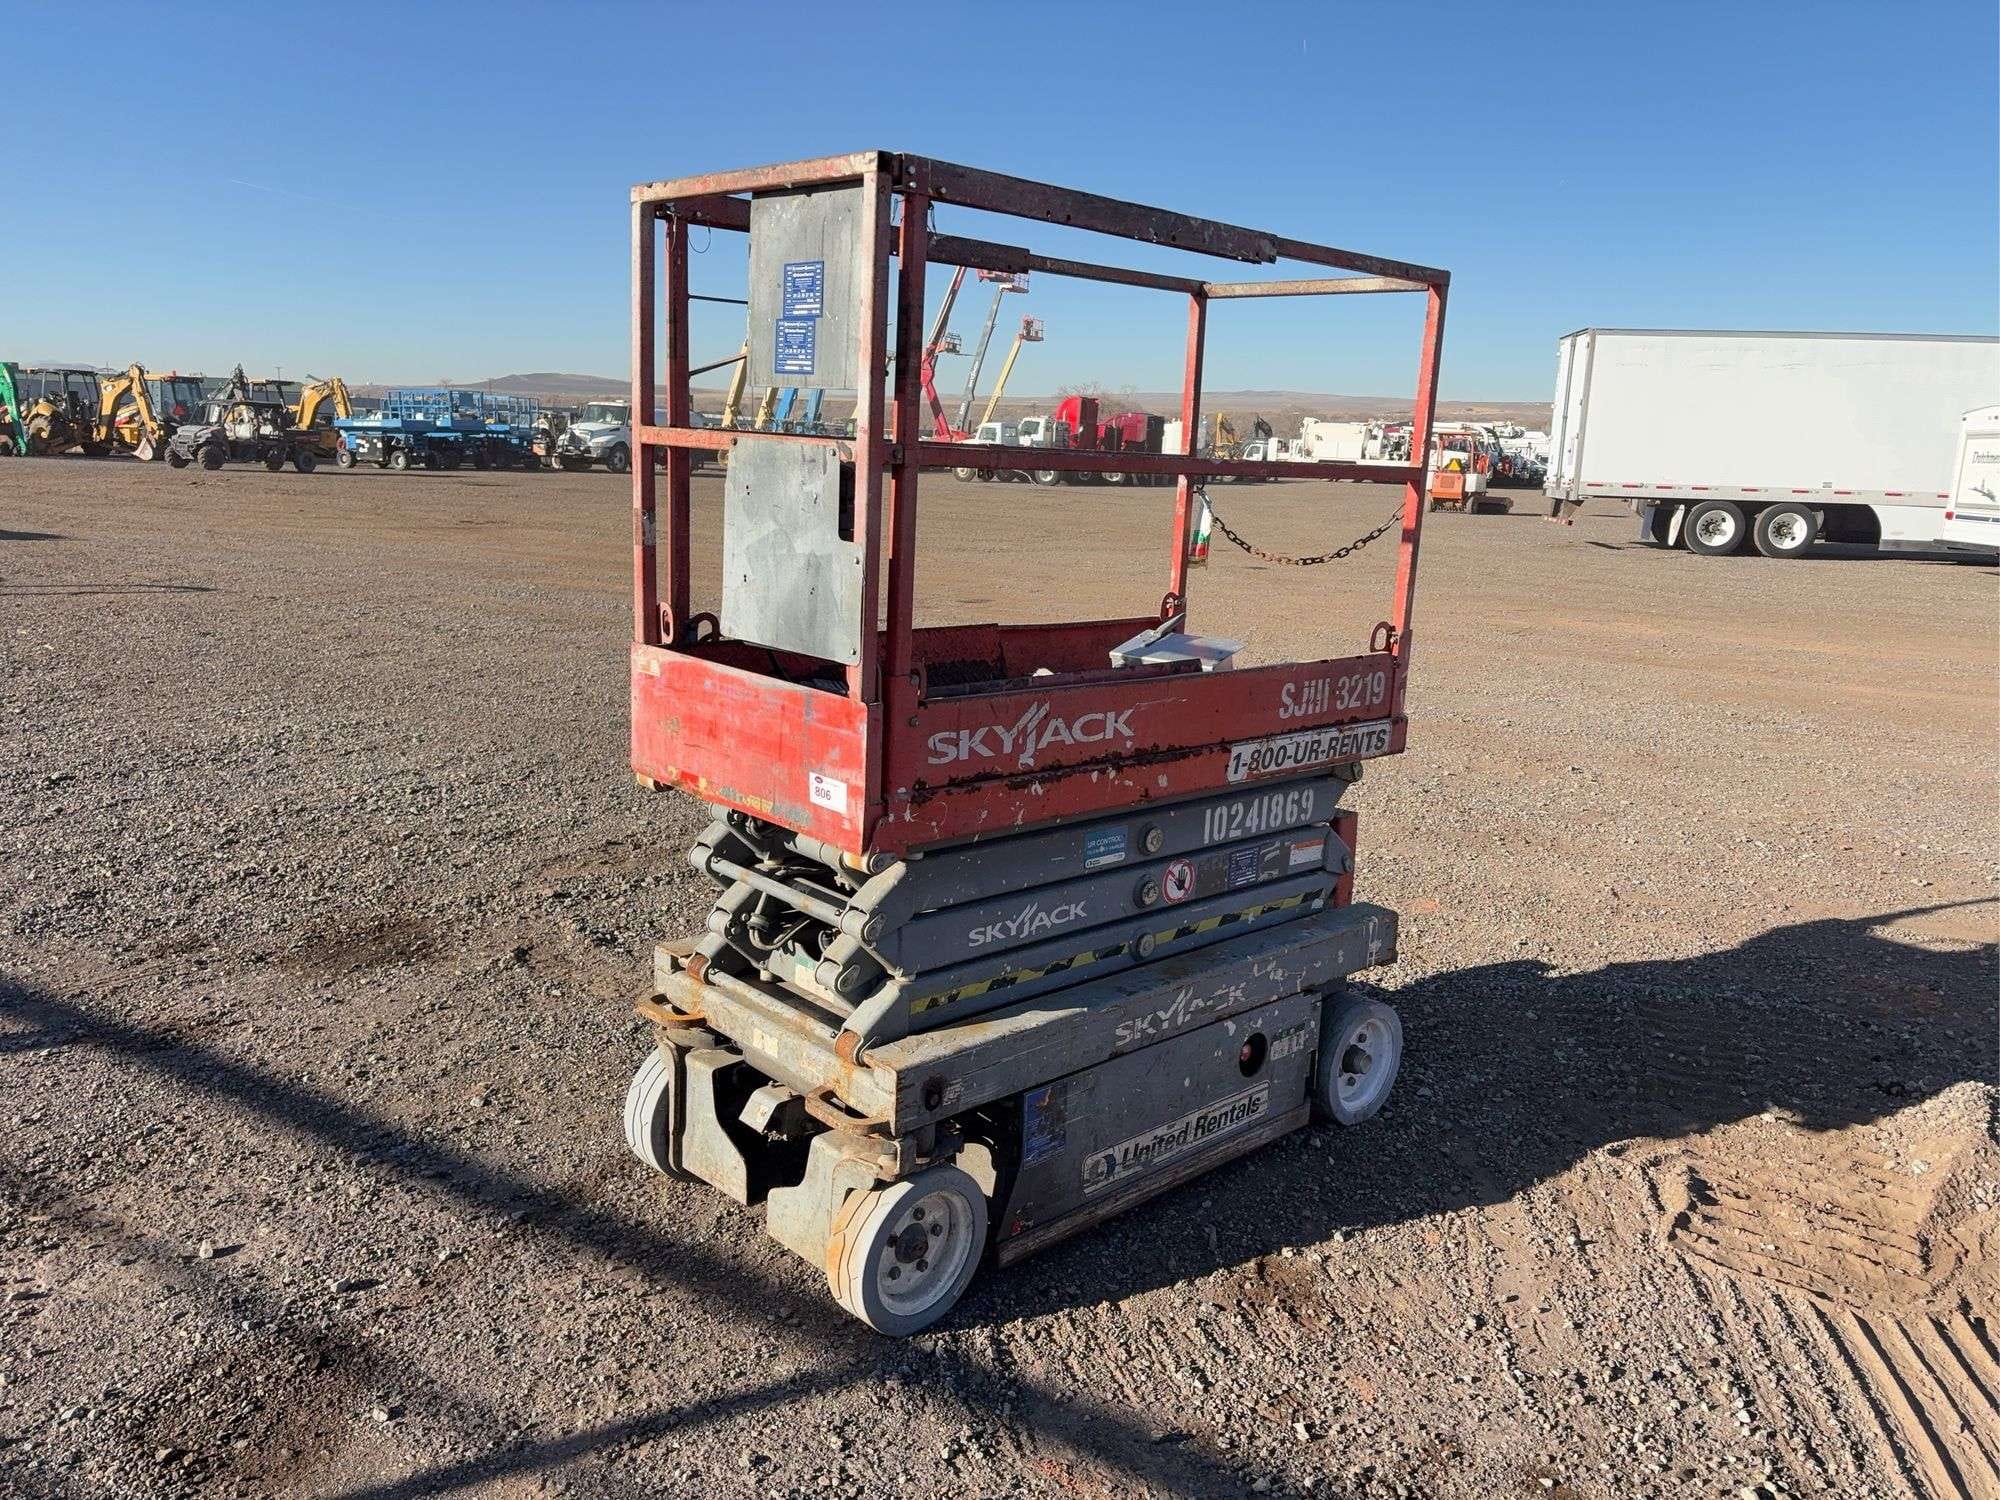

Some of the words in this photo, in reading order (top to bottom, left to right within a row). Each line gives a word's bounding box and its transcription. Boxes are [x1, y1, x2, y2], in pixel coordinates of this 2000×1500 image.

[1336, 671, 1386, 711] 3219
[927, 700, 1135, 770] SKYJACK
[1232, 728, 1388, 776] 1-800-UR-RENTS
[814, 786, 832, 801] 806
[1203, 788, 1315, 845] 10241869
[968, 901, 1089, 948] SKYJACK
[1121, 1121, 1190, 1171] United
[1193, 1095, 1262, 1139] Rentals
